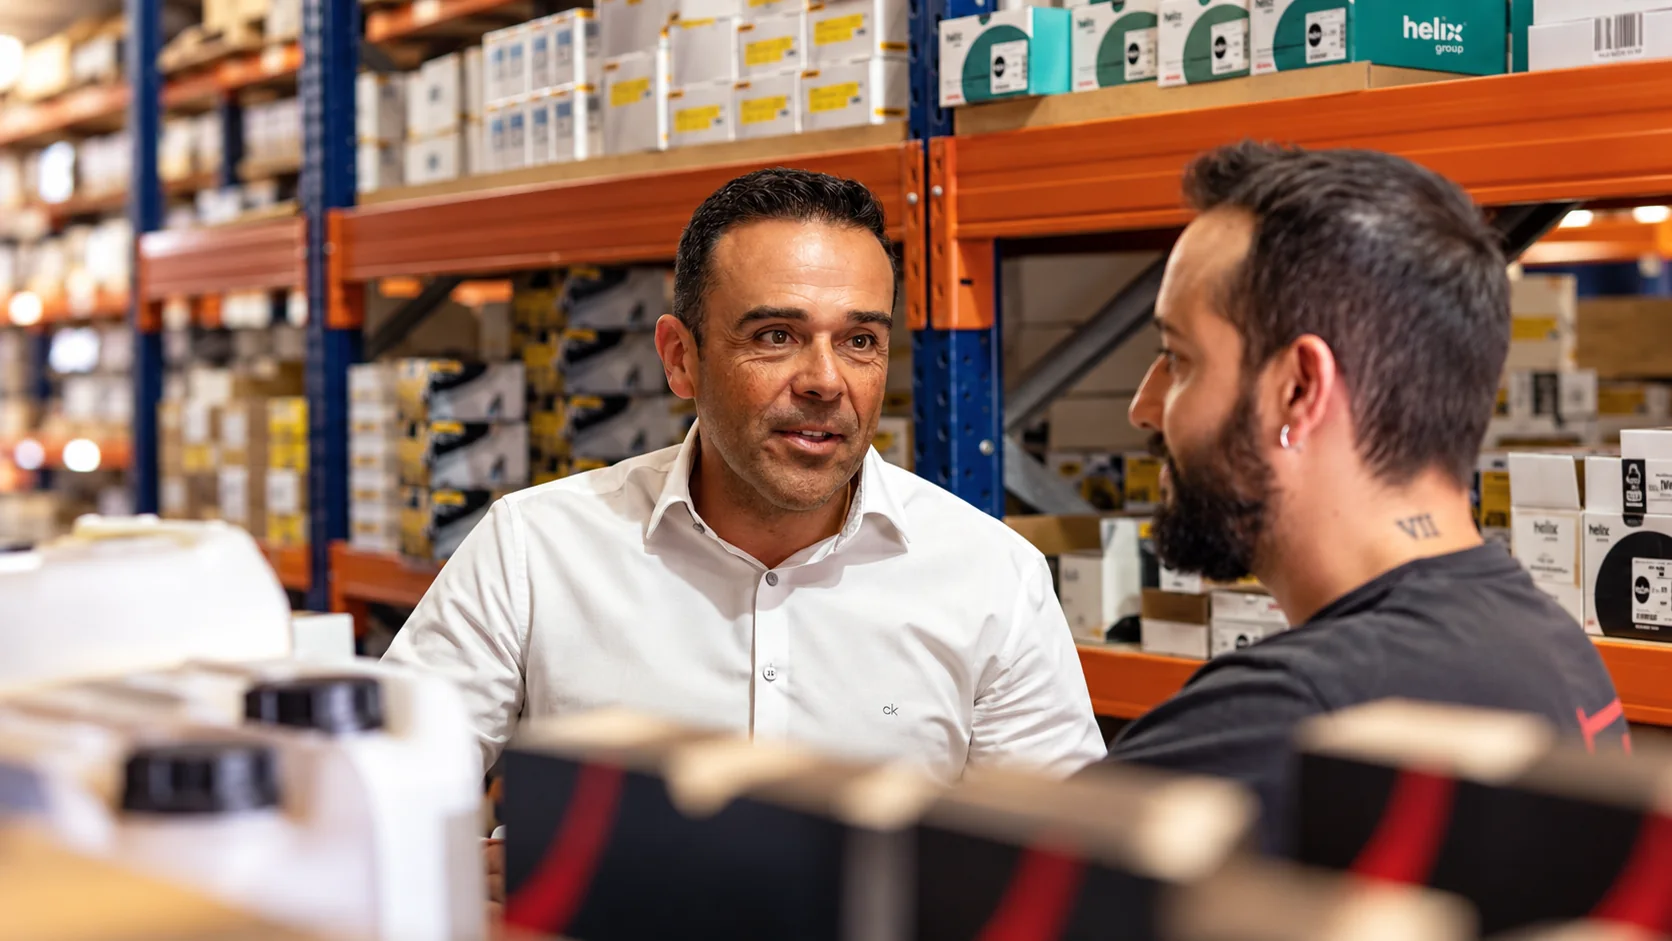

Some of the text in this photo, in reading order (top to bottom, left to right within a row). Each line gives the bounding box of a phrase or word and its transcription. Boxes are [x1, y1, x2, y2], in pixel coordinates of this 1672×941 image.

[1403, 15, 1463, 42] helix
[1435, 44, 1464, 55] group
[1395, 514, 1441, 540] VII
[882, 703, 898, 716] ck
